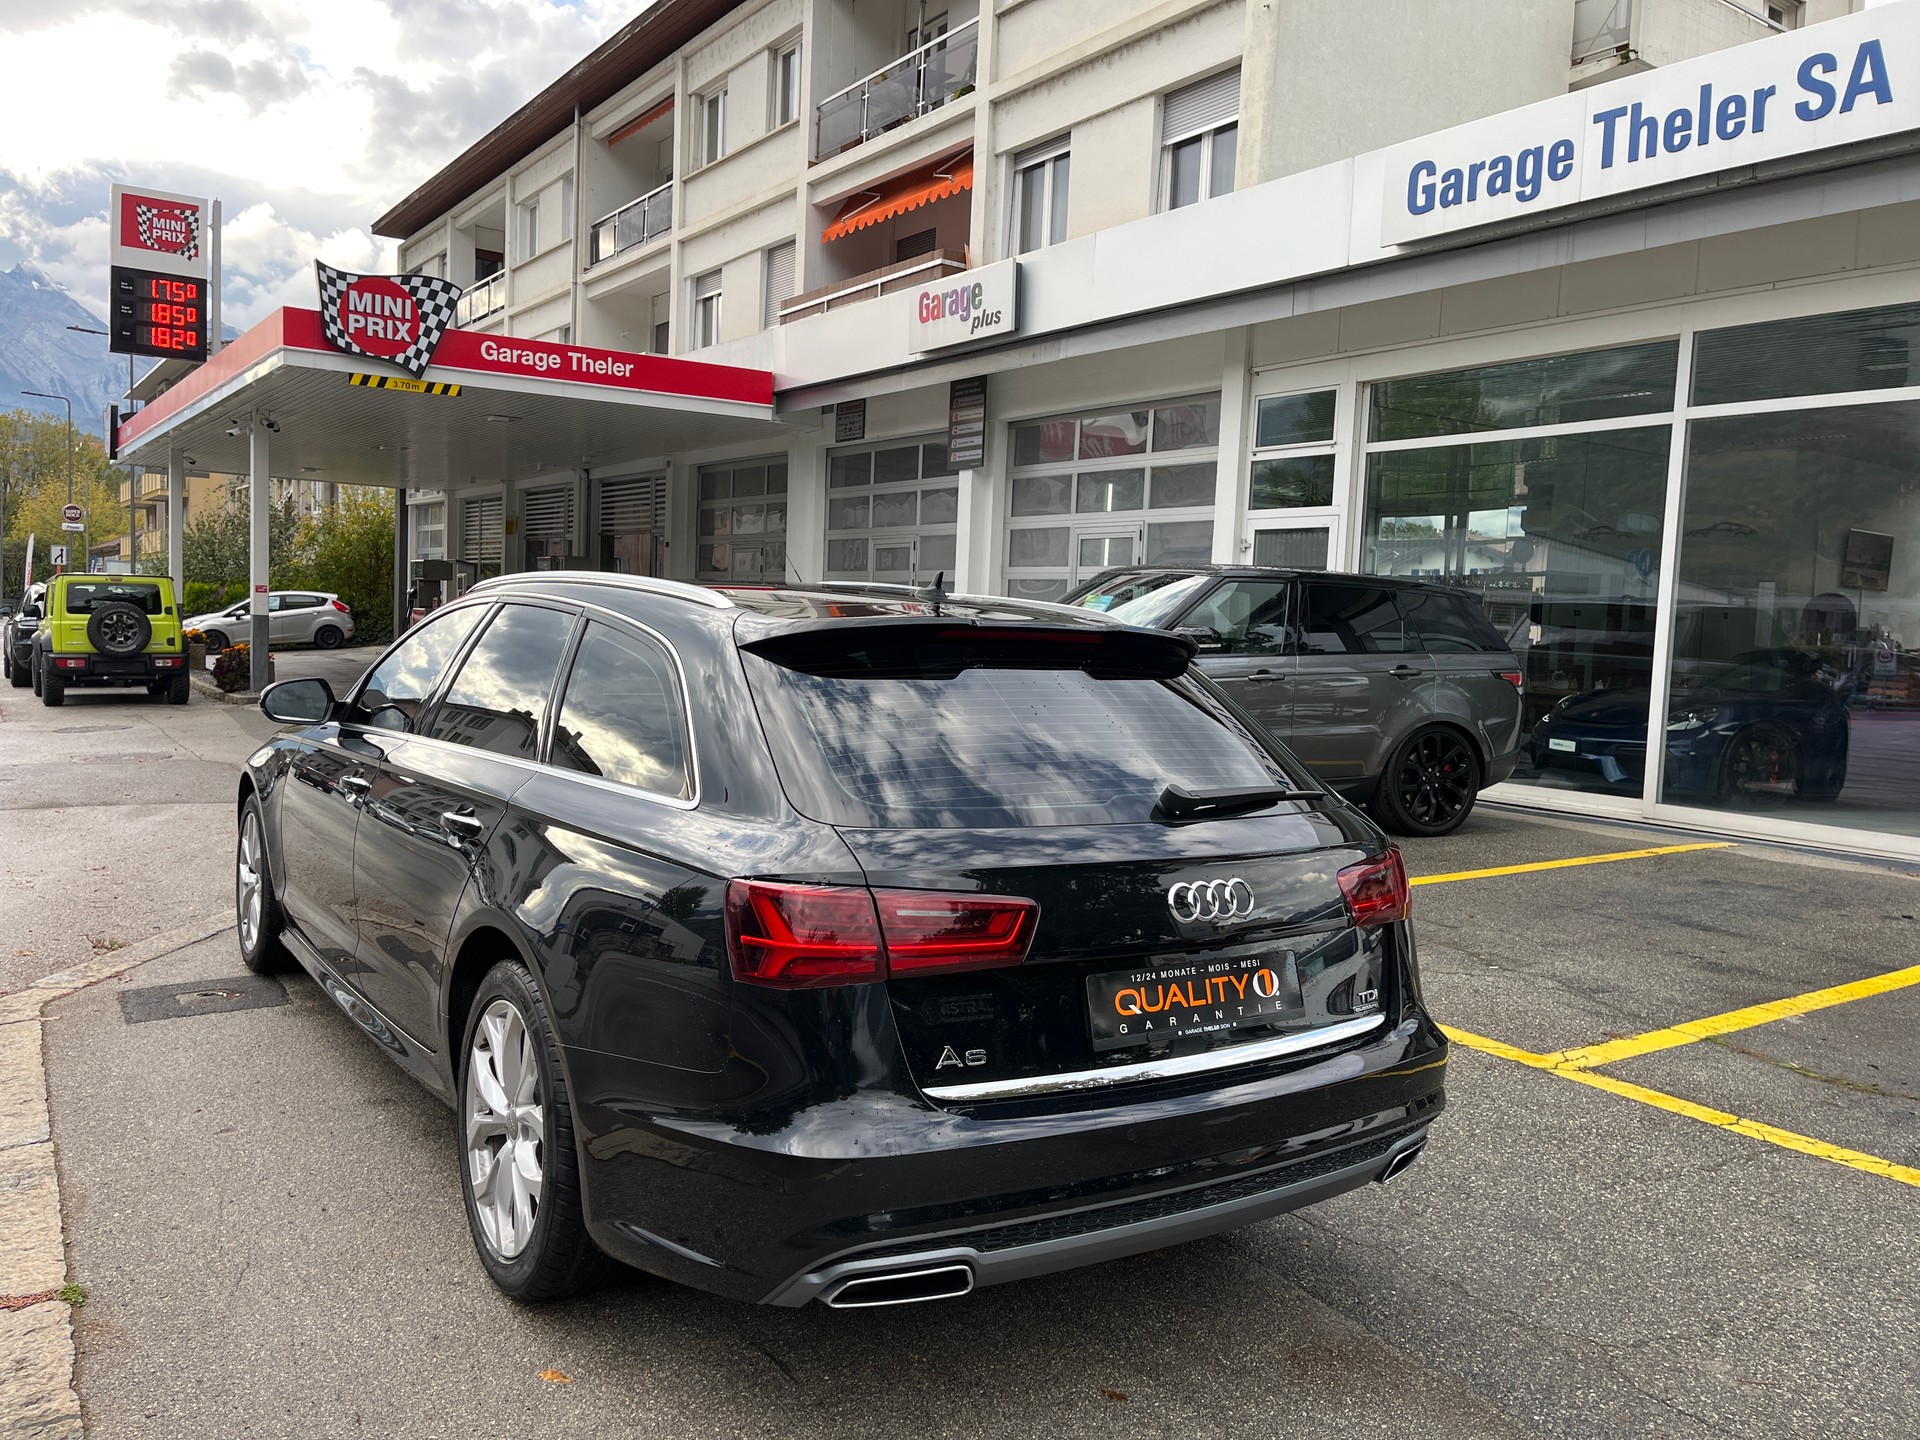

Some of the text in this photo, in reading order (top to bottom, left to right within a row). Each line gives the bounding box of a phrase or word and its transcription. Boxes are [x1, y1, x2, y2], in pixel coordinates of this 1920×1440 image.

[1406, 38, 1894, 216] Garage Theler SA
[152, 216, 186, 233] MINI
[152, 228, 186, 244] PRIX
[348, 290, 412, 320] MINI
[918, 282, 983, 324] Garage
[348, 313, 412, 343] PRIX
[970, 308, 1002, 335] plus
[480, 340, 634, 377] Garage Theler
[1130, 972, 1156, 982] 12/24
[1160, 966, 1197, 979] MONATE
[1208, 963, 1230, 972] MOIS
[1240, 959, 1261, 968] MESI
[1357, 988, 1379, 1004] TDI
[1119, 1000, 1282, 1034] GARANTIE
[1184, 1027, 1203, 1035] GARAGE
[935, 1045, 987, 1070] A6
